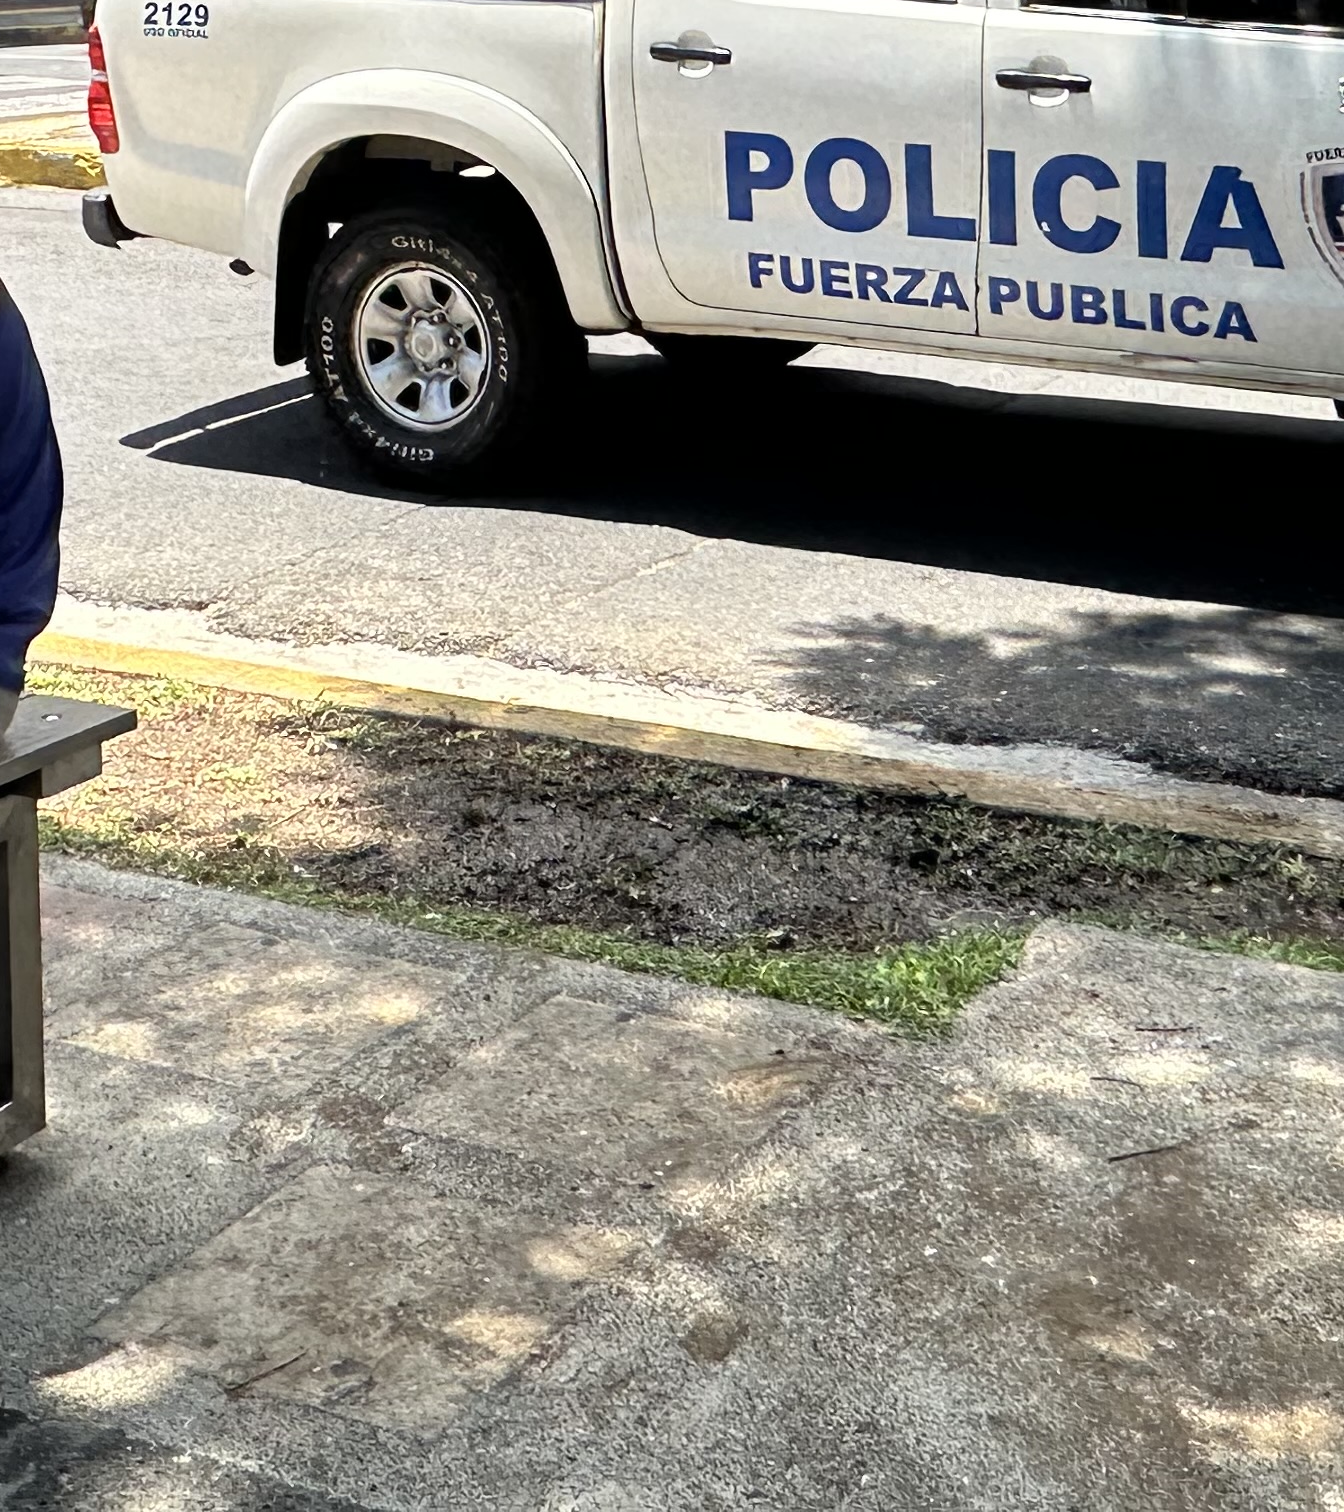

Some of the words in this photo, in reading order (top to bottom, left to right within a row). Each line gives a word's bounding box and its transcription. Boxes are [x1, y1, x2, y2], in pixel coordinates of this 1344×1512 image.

[144, 1, 209, 27] 2129
[723, 130, 1286, 270] POLICIA
[748, 251, 970, 312] FUERZA
[988, 275, 1259, 343] PUBLICA
